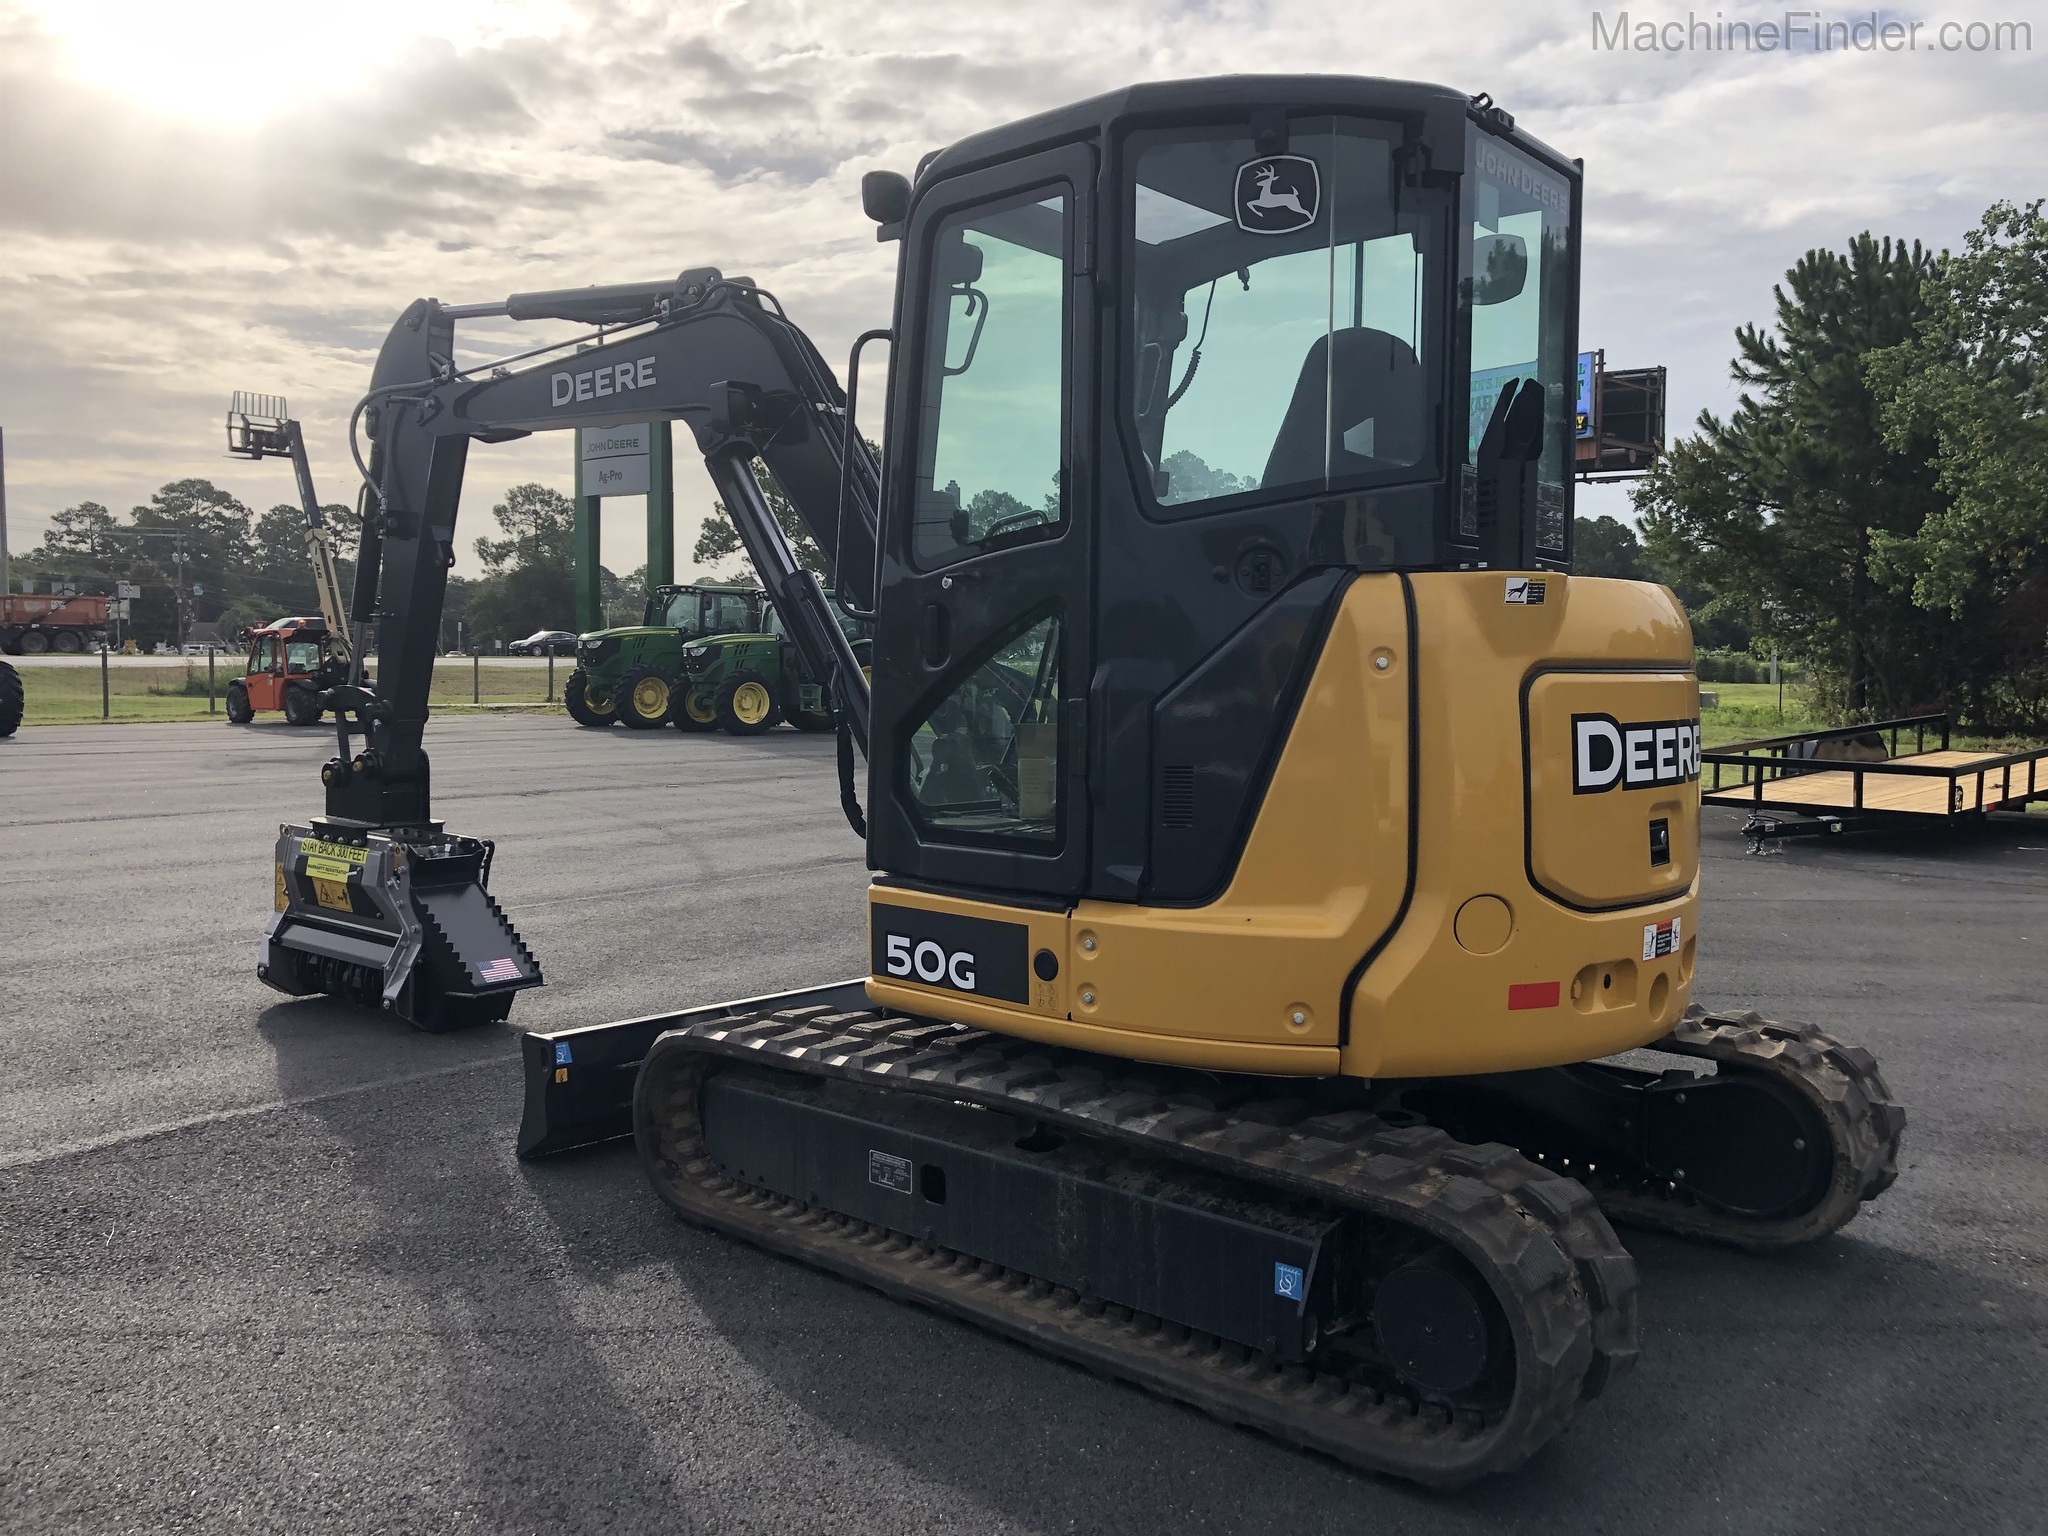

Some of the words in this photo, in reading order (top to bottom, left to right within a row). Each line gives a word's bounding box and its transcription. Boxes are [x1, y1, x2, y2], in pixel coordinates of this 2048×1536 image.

[1476, 144, 1519, 187] JOHN
[1521, 168, 1568, 215] DEERE
[551, 355, 657, 407] DEERE
[586, 441, 607, 453] JOHN
[607, 438, 639, 450] DEERE
[598, 470, 623, 483] Ag-Pro
[1576, 719, 1701, 787] DEERE
[302, 840, 319, 852] STAY
[318, 842, 337, 856] BACK
[348, 848, 367, 862] FEET
[887, 934, 975, 990] 50G
